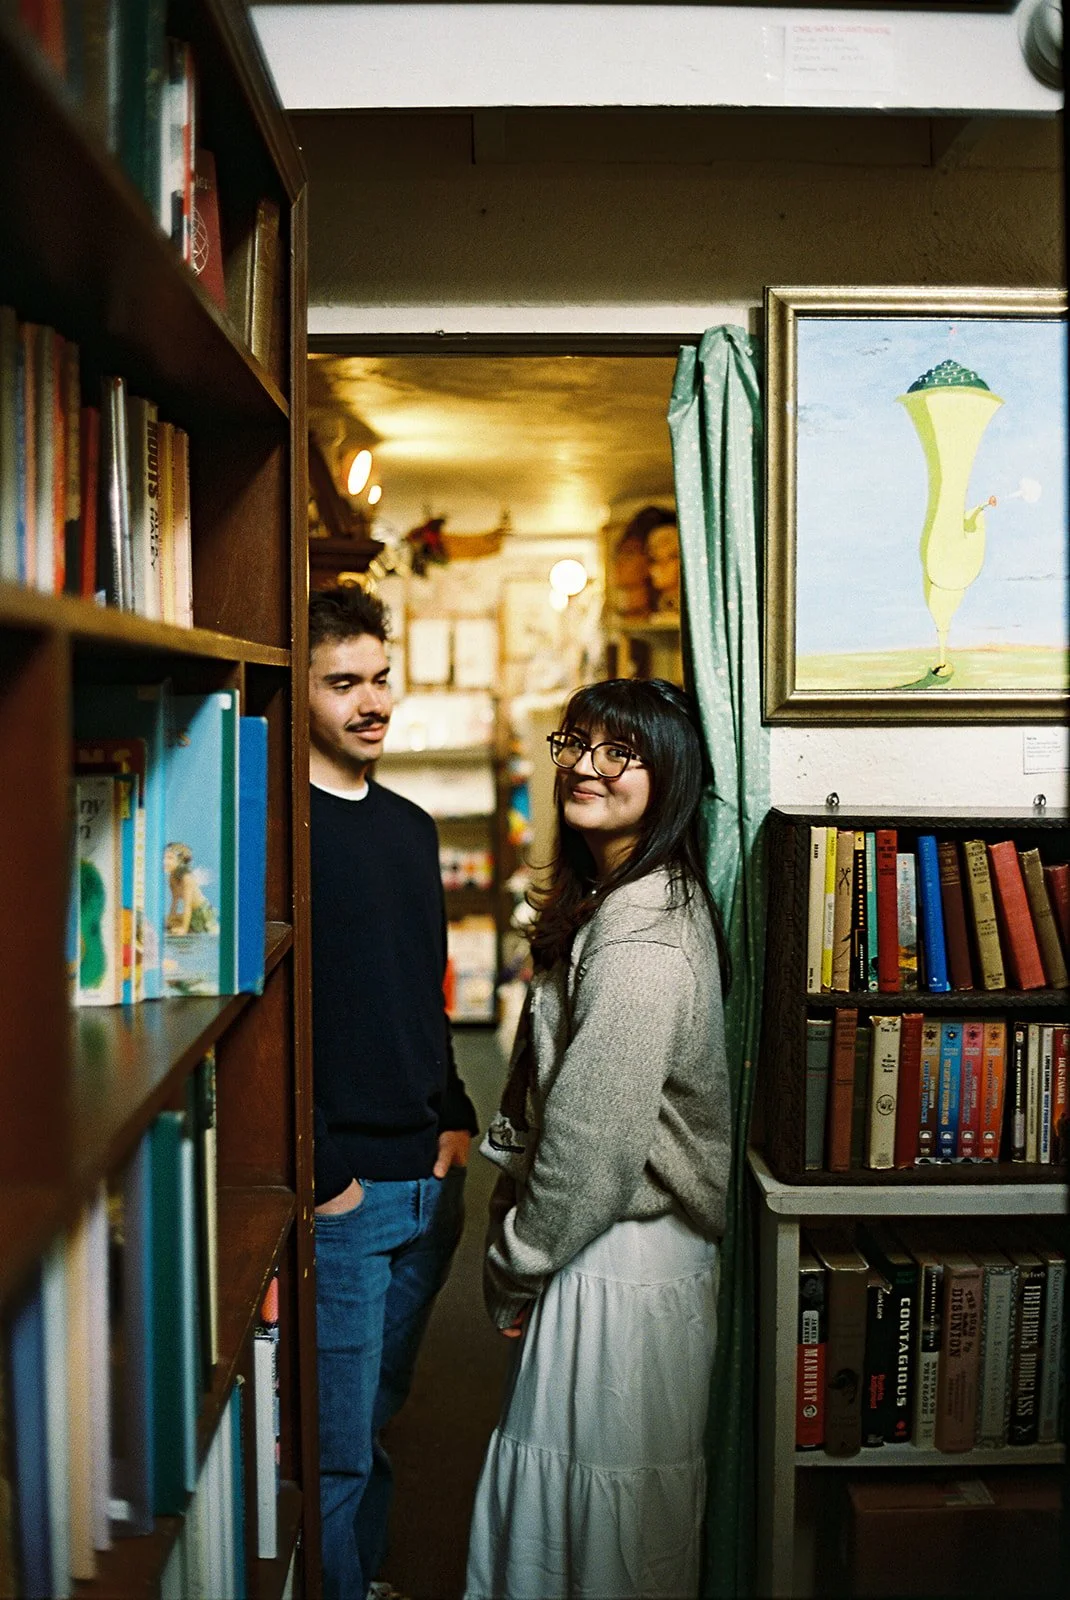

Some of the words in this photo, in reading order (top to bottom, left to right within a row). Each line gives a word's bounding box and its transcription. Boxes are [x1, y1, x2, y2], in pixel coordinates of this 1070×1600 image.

[147, 420, 159, 500] ROOTS
[1057, 1057, 1067, 1076] LOUIS
[1057, 1077, 1066, 1104] L'AMOUR
[964, 1290, 976, 1310] THE
[1051, 1269, 1063, 1304] KILLING
[876, 1304, 884, 1319] Lane
[949, 1288, 964, 1359] DISUNION
[968, 1313, 977, 1337] ROAD
[1020, 1285, 1042, 1349] FREDERICK
[803, 1317, 811, 1344] SWANSO
[896, 1297, 912, 1408] CONTAGIOUS
[963, 1341, 974, 1353] TO
[803, 1348, 818, 1402] MANHUNT
[1016, 1353, 1038, 1417] DOUGLASS
[922, 1383, 930, 1414] GLOBE
[930, 1401, 936, 1414] ON
